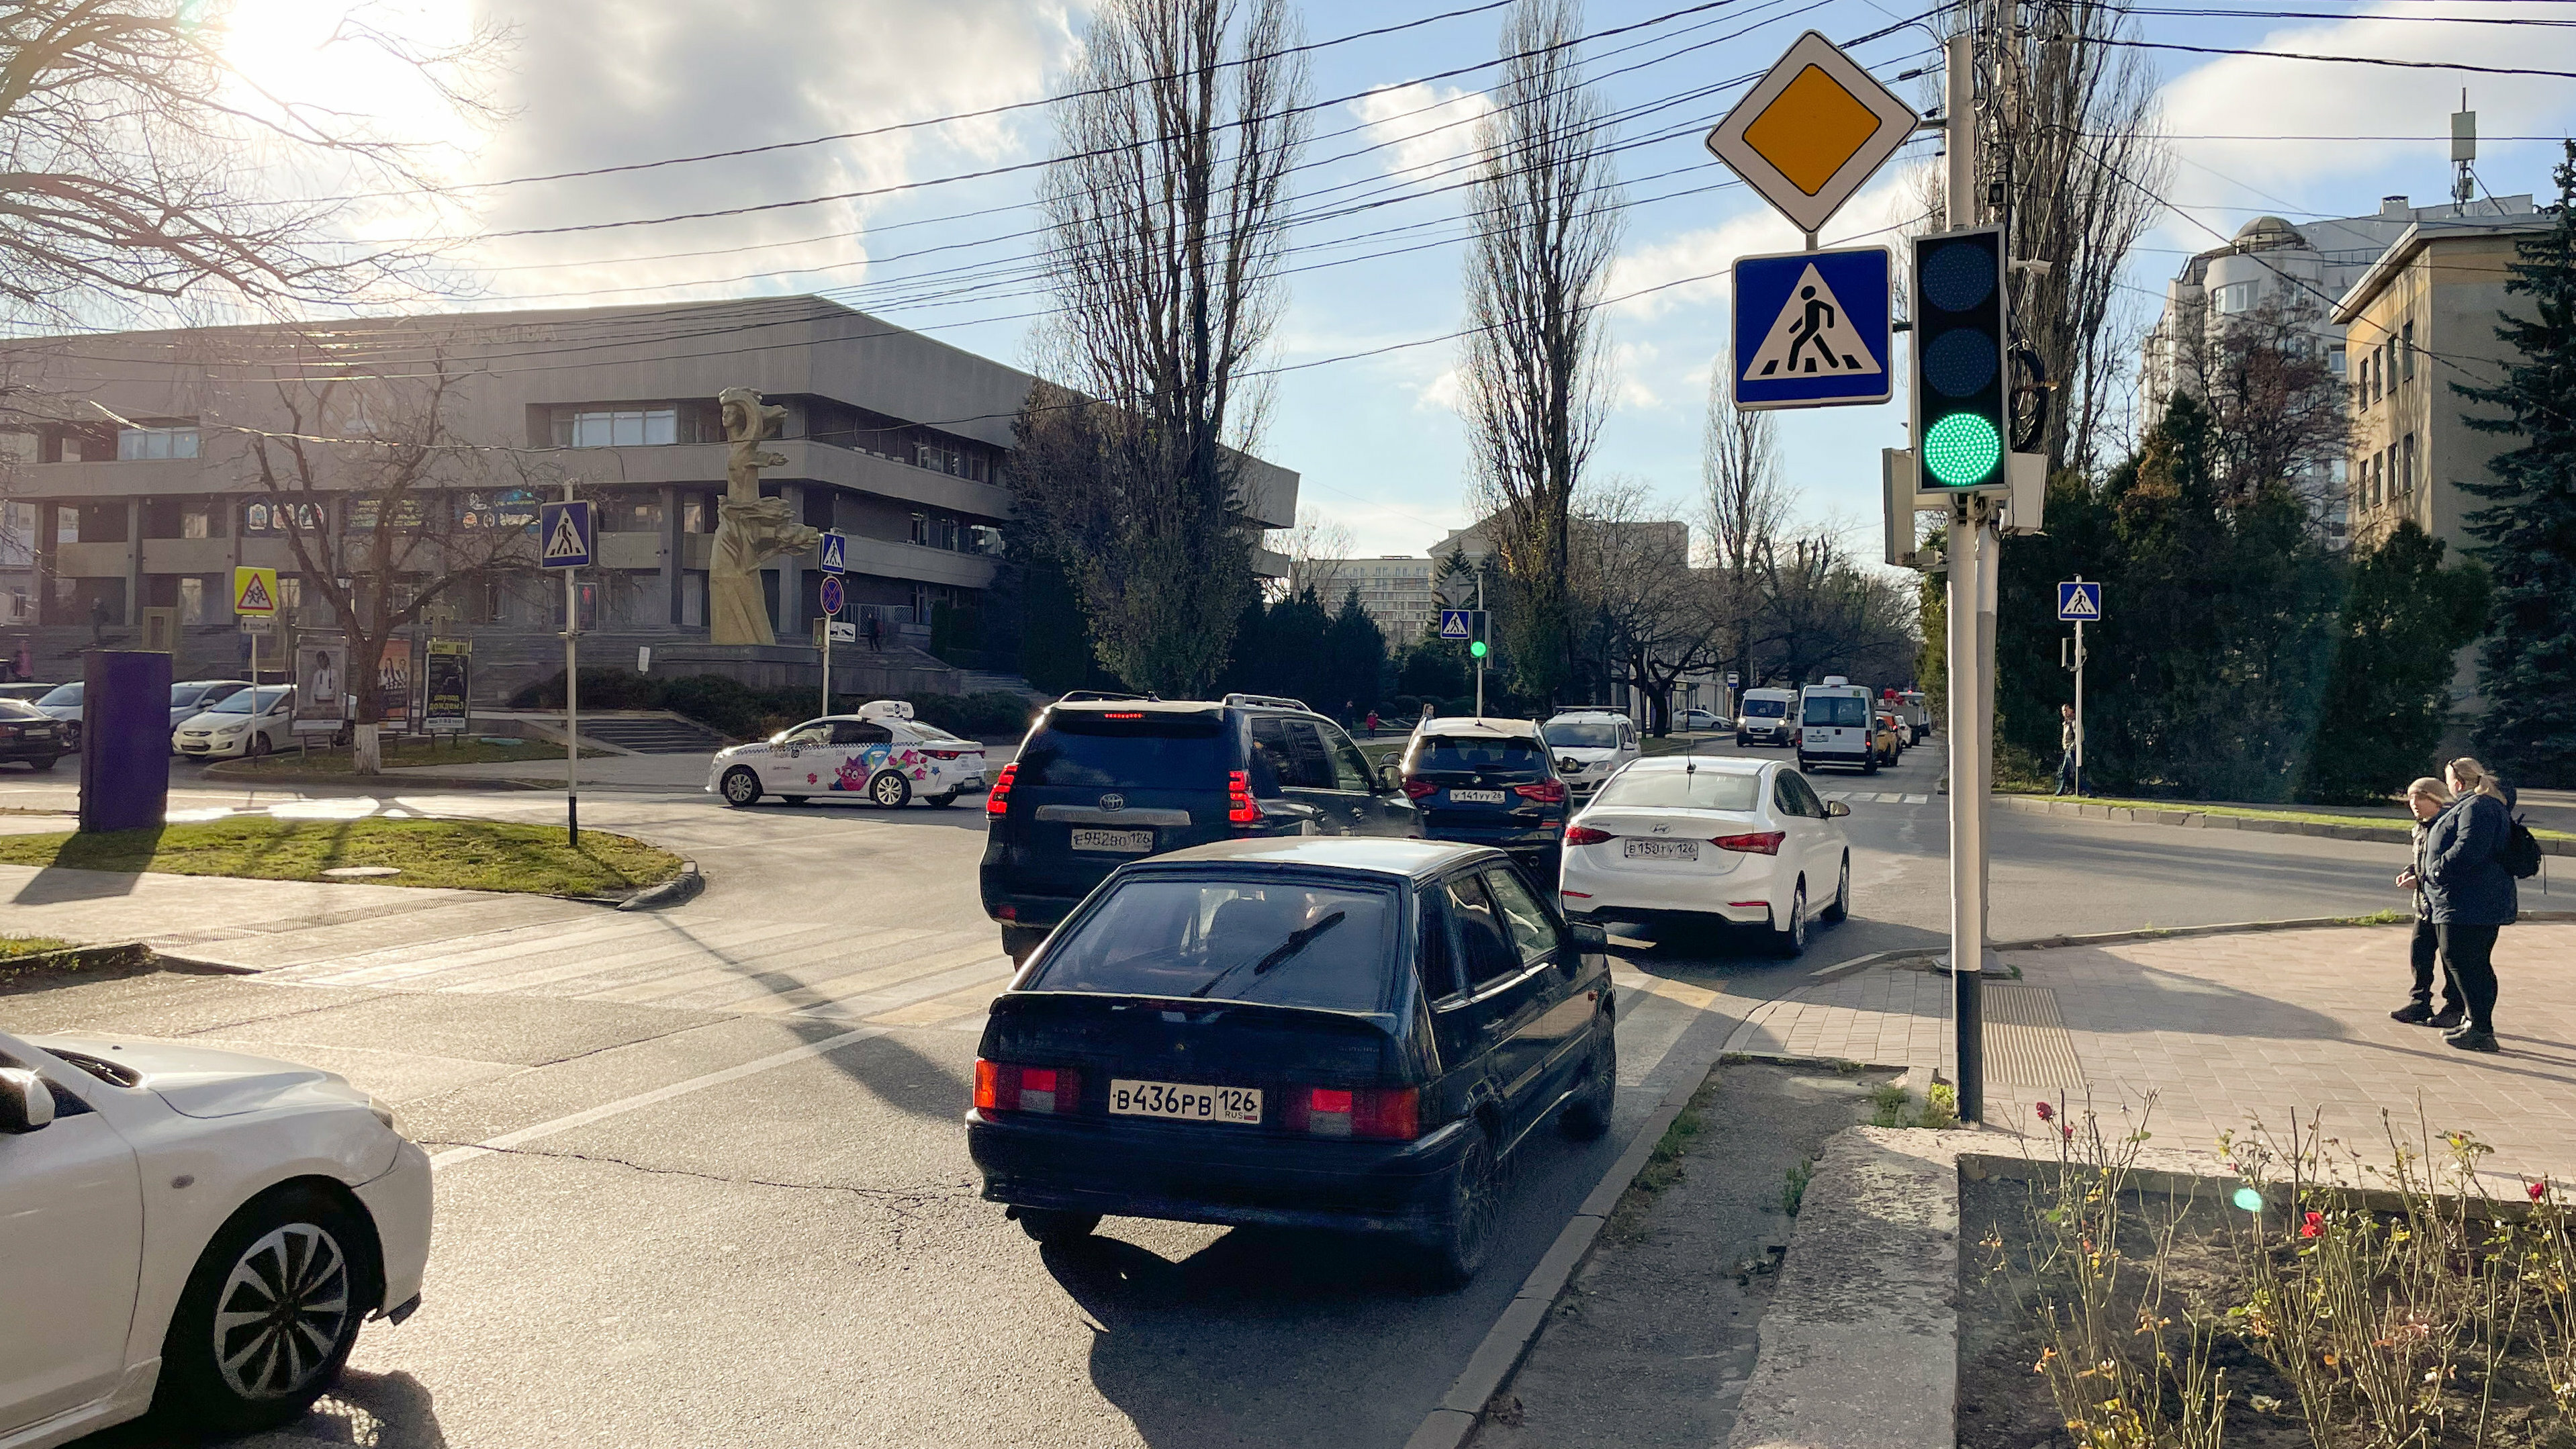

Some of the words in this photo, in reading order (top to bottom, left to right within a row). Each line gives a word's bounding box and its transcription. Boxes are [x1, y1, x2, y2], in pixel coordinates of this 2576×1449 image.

[1678, 844, 1695, 853] 126
[1116, 1085, 1211, 1116] В436РВ
[1219, 1090, 1257, 1112] 126
[1225, 1110, 1243, 1119] RUS
